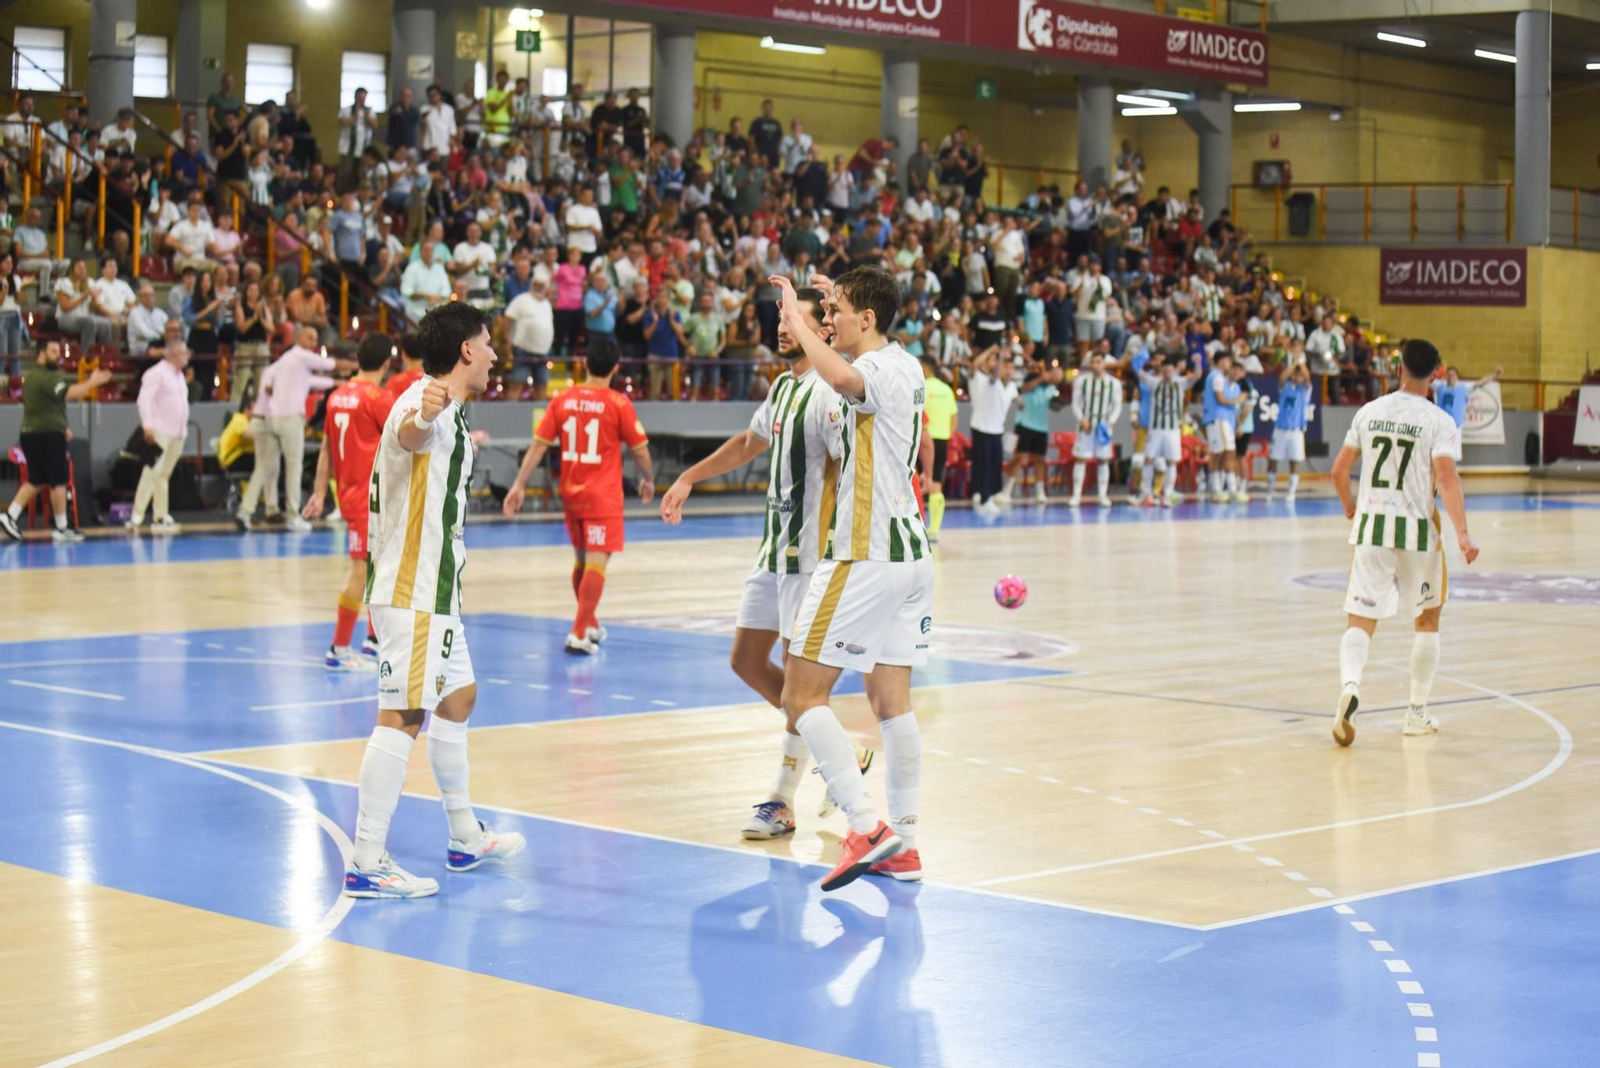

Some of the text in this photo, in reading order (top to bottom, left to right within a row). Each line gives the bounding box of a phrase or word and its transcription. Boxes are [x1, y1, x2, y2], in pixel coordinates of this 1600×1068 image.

[1057, 14, 1118, 38] Diputación
[523, 32, 536, 50] D
[1057, 34, 1072, 50] de
[1189, 30, 1265, 65] IMDECO
[1416, 259, 1521, 285] IMDECO
[334, 412, 350, 461] 7
[562, 415, 602, 463] 11
[1368, 420, 1397, 434] CARLOS
[1371, 435, 1415, 491] 27
[441, 628, 454, 659] 9
